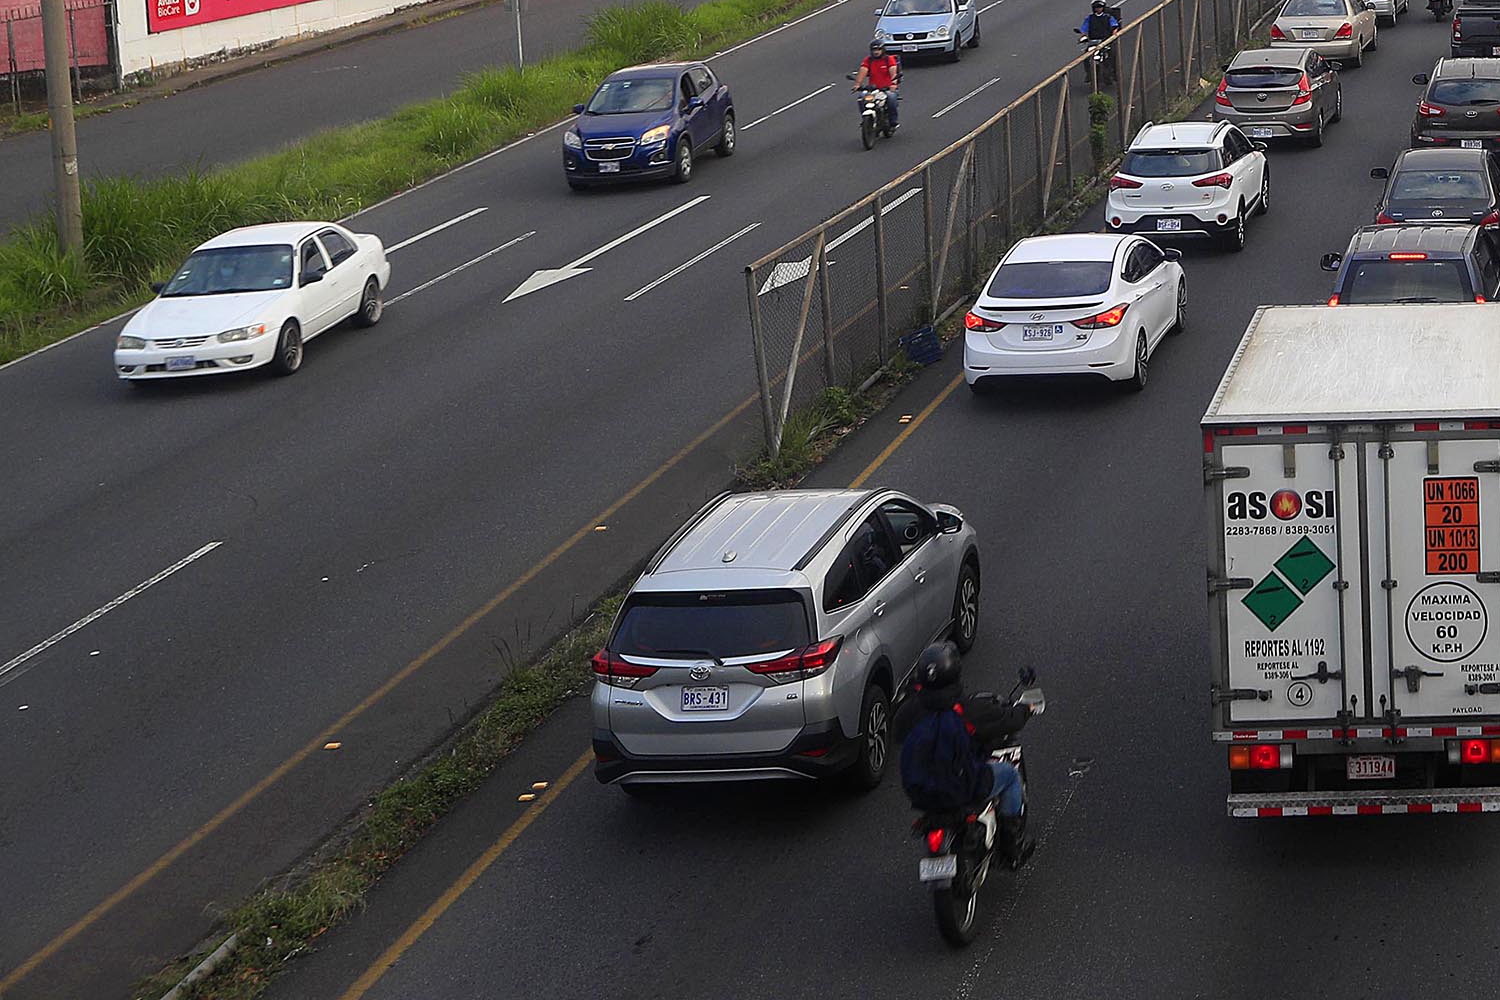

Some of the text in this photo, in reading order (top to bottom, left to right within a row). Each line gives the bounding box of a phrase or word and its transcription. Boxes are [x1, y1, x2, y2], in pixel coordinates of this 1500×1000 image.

[157, 5, 181, 17] BioCare
[1427, 482, 1475, 500] UN 1066
[1442, 506, 1462, 523] 20
[1226, 526, 1277, 536] 2283-7868
[1285, 525, 1335, 535] 8389-3061
[1429, 529, 1476, 547] UN 1013
[1438, 553, 1468, 571] 200
[1302, 579, 1309, 589] 2
[1422, 595, 1471, 605] MAXIMA
[1269, 615, 1277, 625] 2
[1412, 611, 1481, 621] VELOCIDAD
[1436, 626, 1458, 639] 60
[1244, 638, 1325, 657] REPORTES AL 1192
[1432, 643, 1463, 653] K.P.H
[1257, 661, 1299, 671] REPORTESE AL
[1460, 664, 1495, 673] REPORTESE
[684, 692, 726, 705] BRS-431
[1296, 687, 1305, 701] 4
[1452, 706, 1482, 714] PAYLOAD
[1355, 760, 1393, 773] 311944
